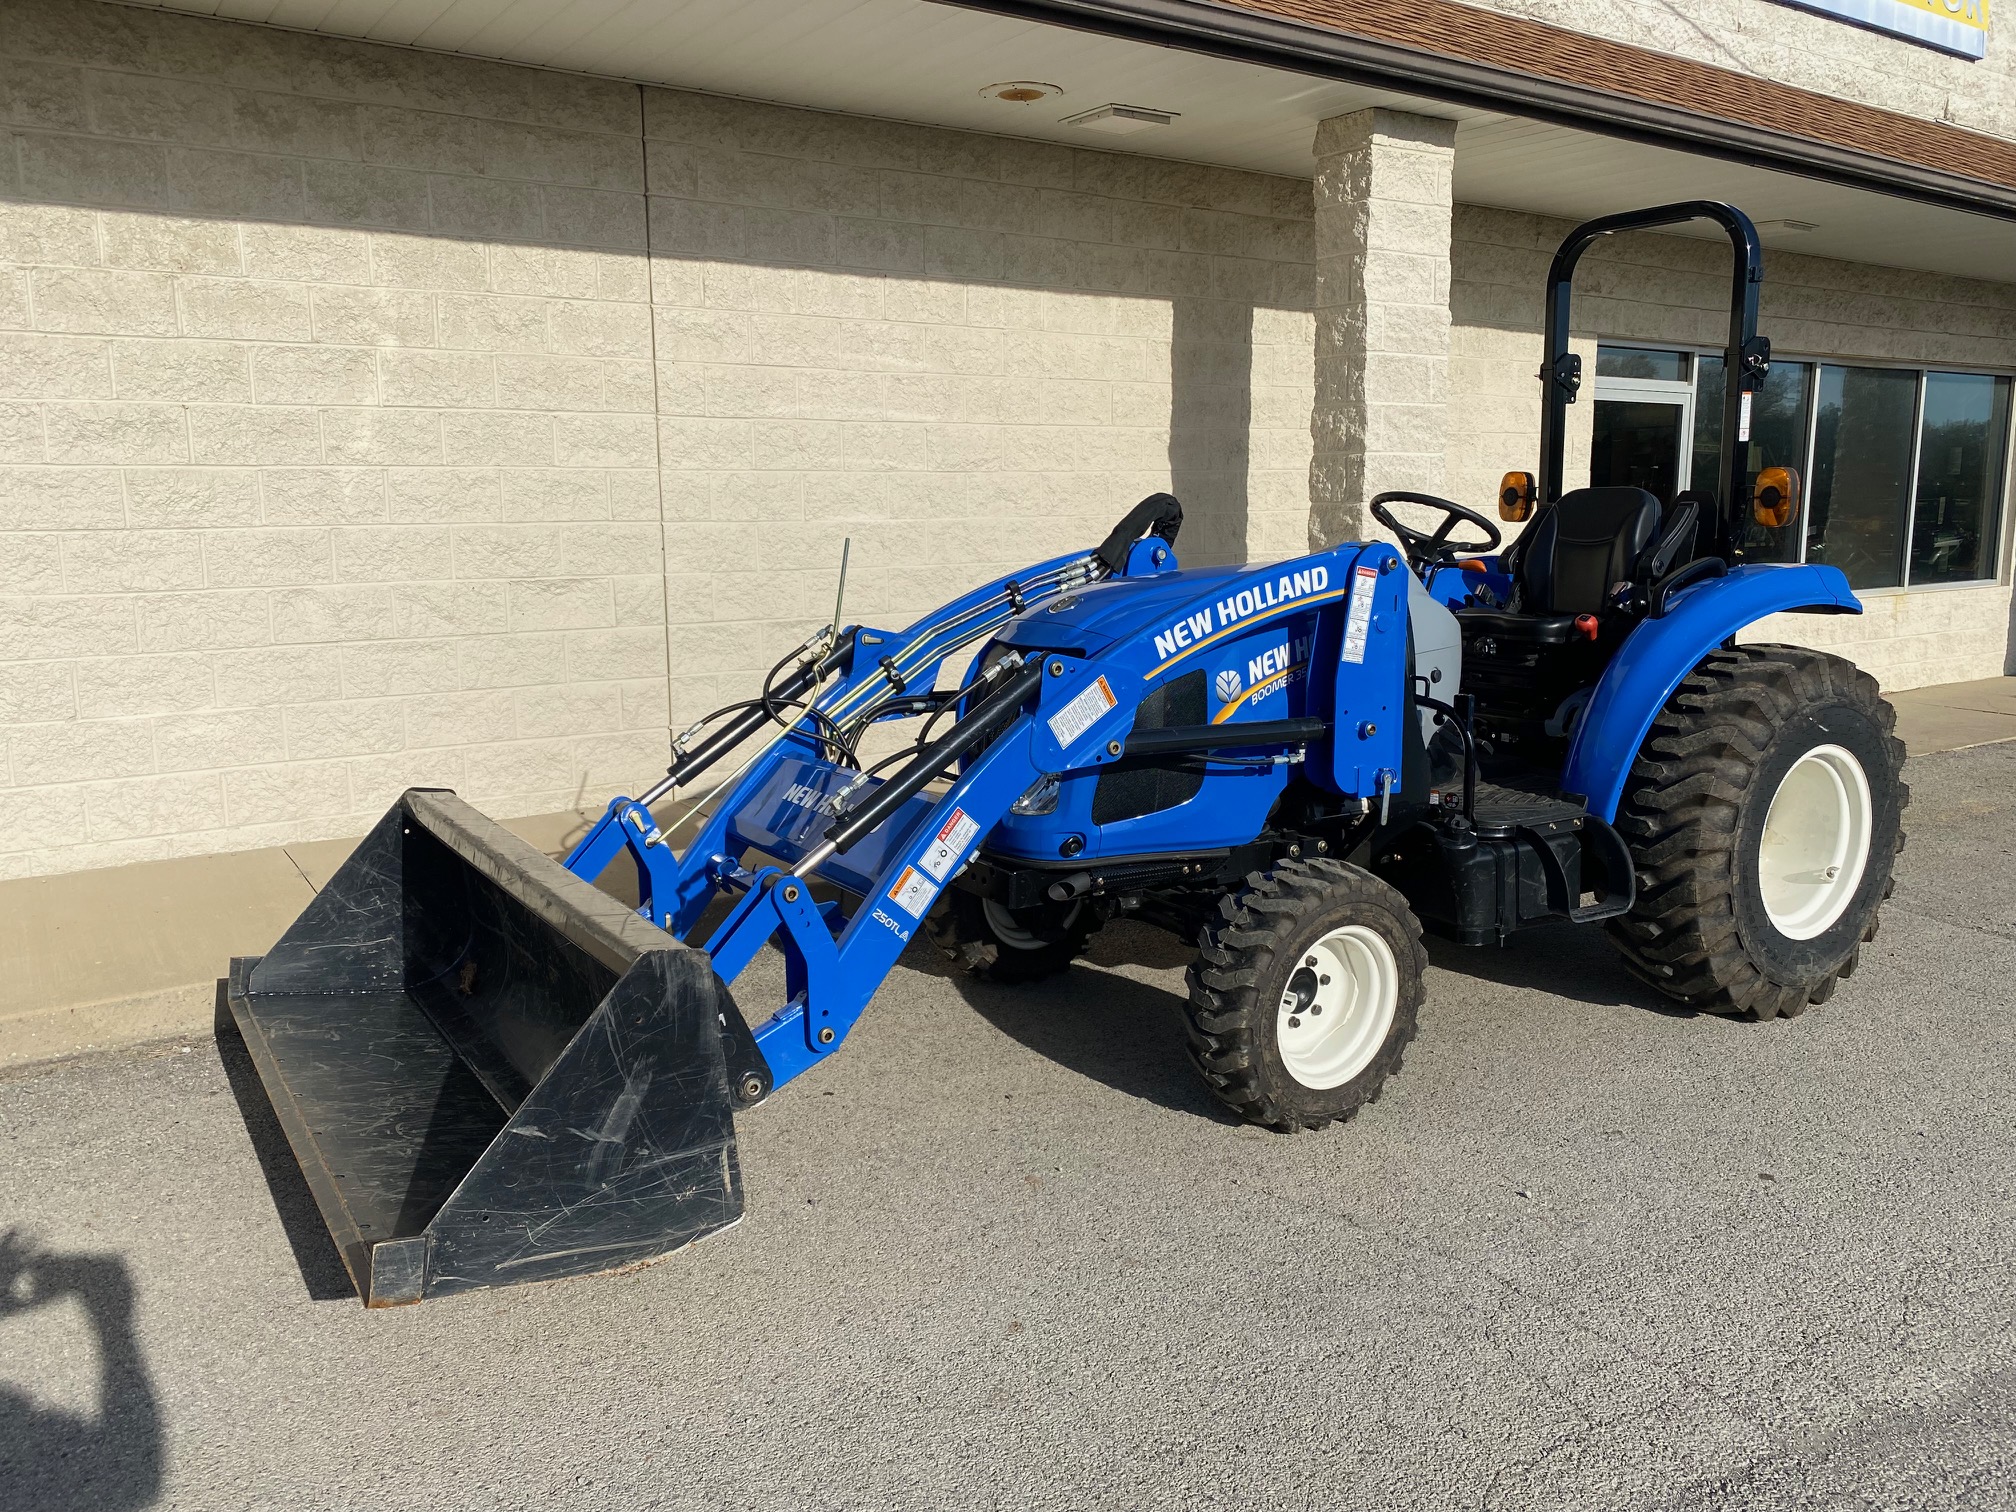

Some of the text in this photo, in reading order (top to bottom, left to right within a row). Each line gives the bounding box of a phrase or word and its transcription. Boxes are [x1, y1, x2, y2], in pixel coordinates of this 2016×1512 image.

[1153, 608, 1213, 660] NEW
[1216, 566, 1328, 626] HOLLAND
[1248, 642, 1290, 685] NEW
[1251, 673, 1294, 706] BOOMER
[782, 783, 822, 808] NEW
[943, 811, 961, 833] DANGER
[871, 908, 910, 942] 250TLA
